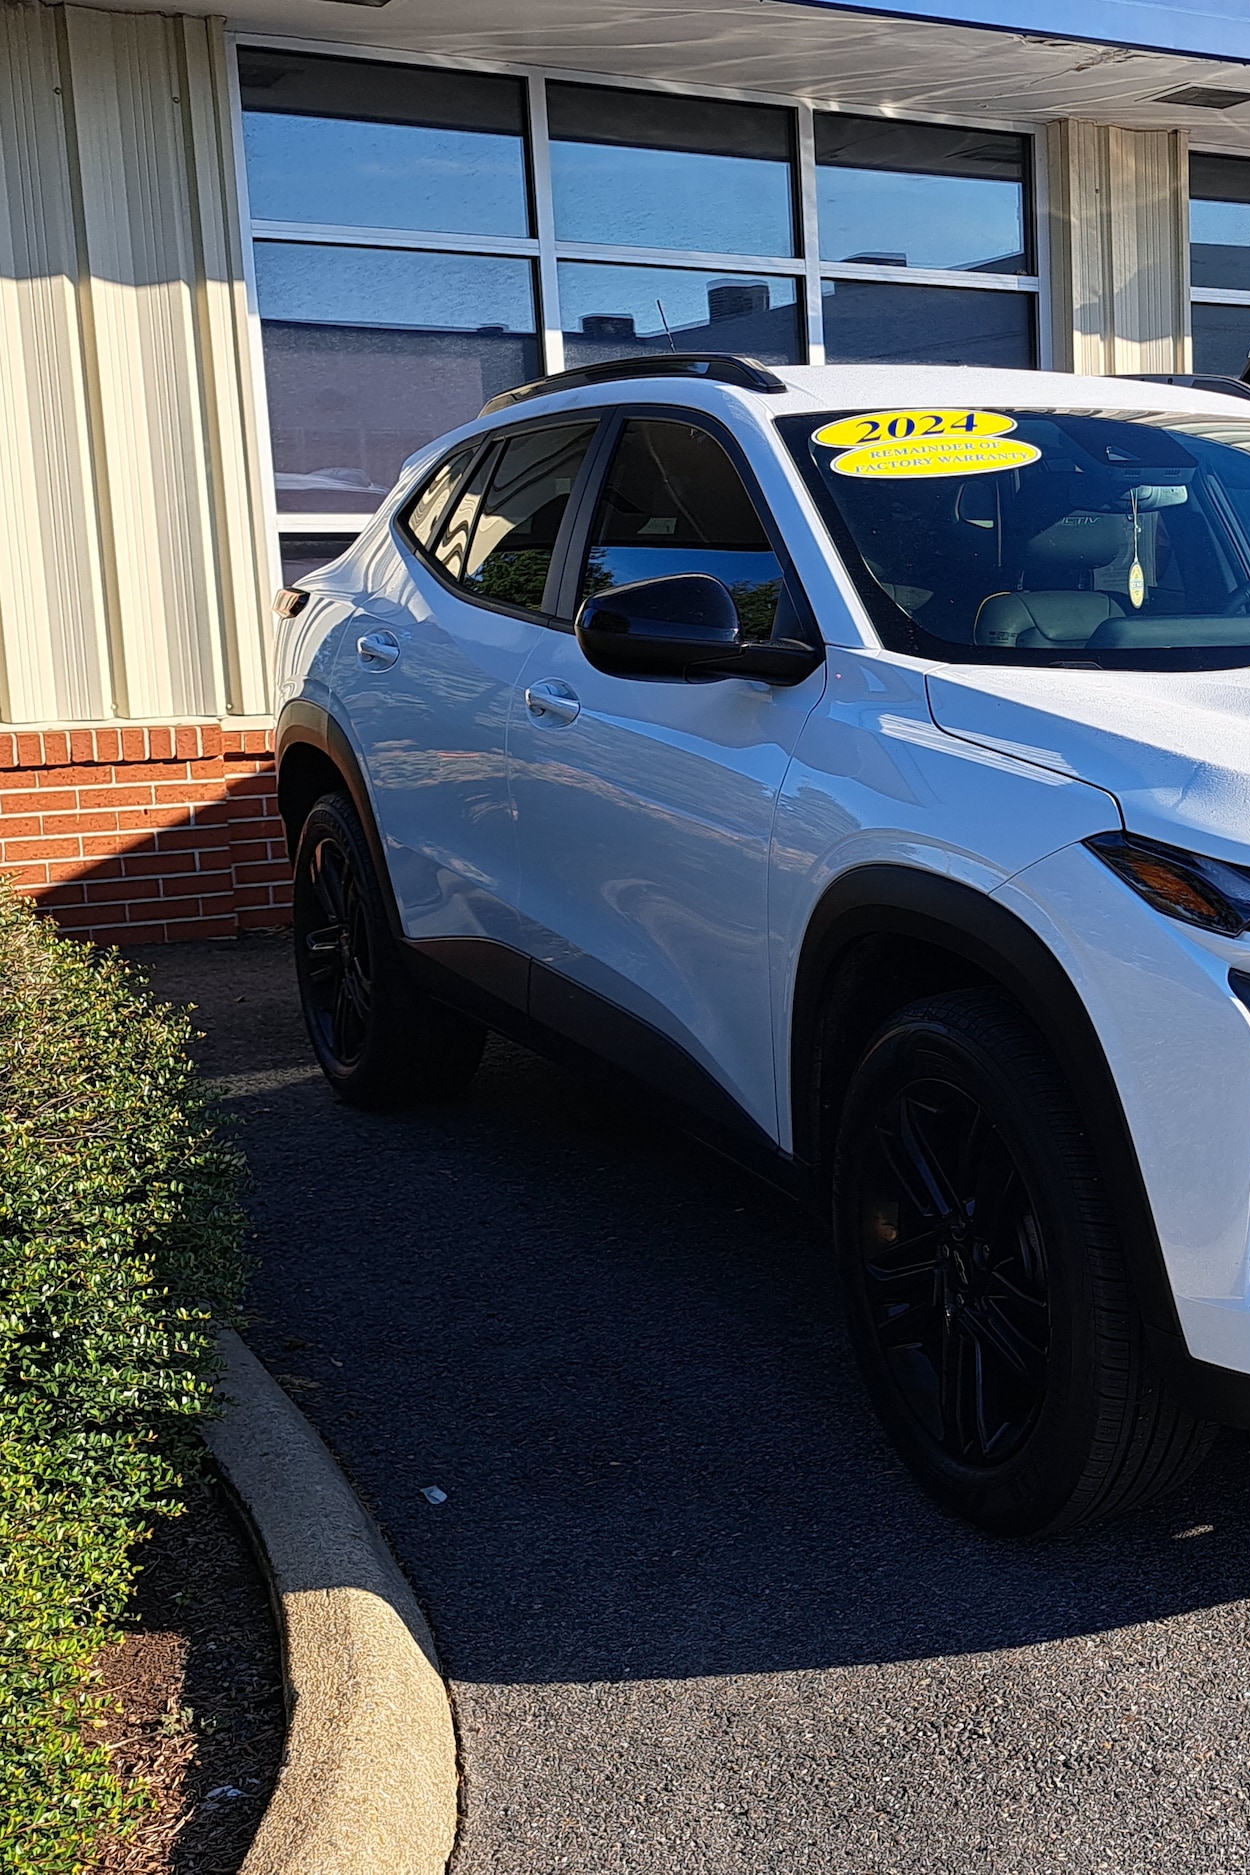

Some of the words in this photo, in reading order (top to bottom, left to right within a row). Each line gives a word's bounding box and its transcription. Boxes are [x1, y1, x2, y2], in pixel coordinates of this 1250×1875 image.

[856, 413, 978, 444] 2024
[869, 442, 975, 459] REMAINDER
[976, 441, 1002, 450] OF
[855, 457, 934, 474] FACTORY
[938, 451, 1029, 465] WARRANTY
